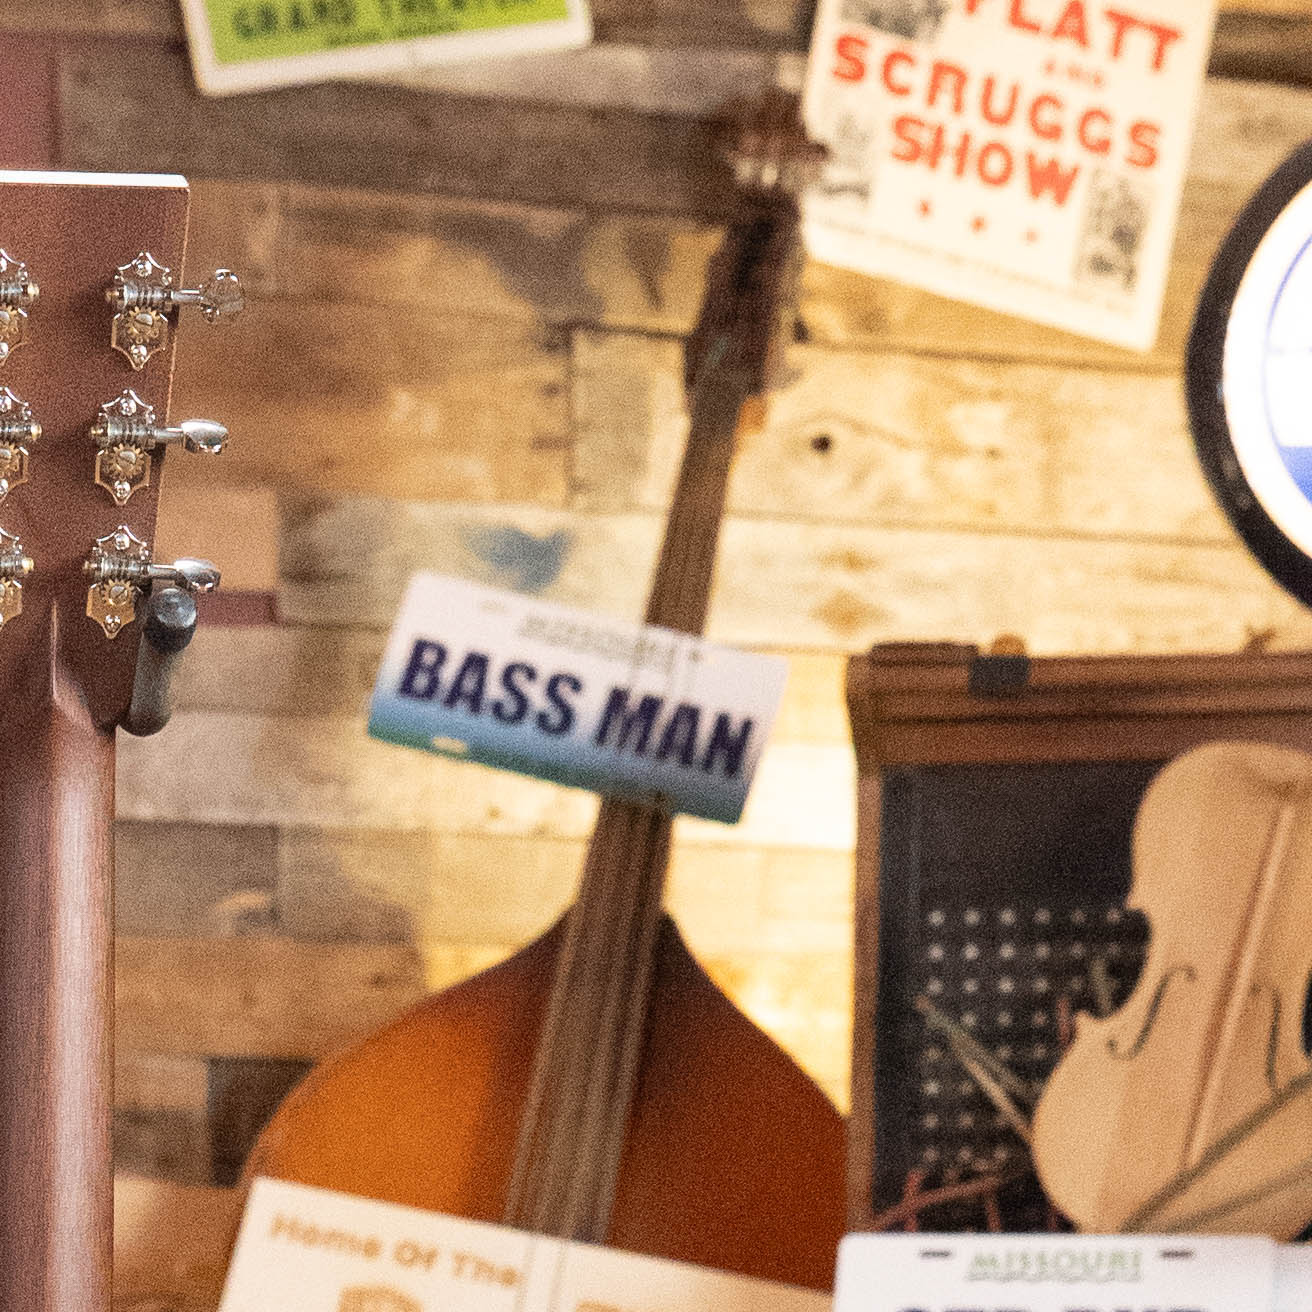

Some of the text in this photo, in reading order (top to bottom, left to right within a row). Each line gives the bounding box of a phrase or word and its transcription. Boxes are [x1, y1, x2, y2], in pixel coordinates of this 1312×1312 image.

[833, 33, 1161, 169] SCRUGGS
[890, 114, 1081, 207] SHOW
[398, 637, 584, 736] BASS
[596, 685, 755, 779] MAN
